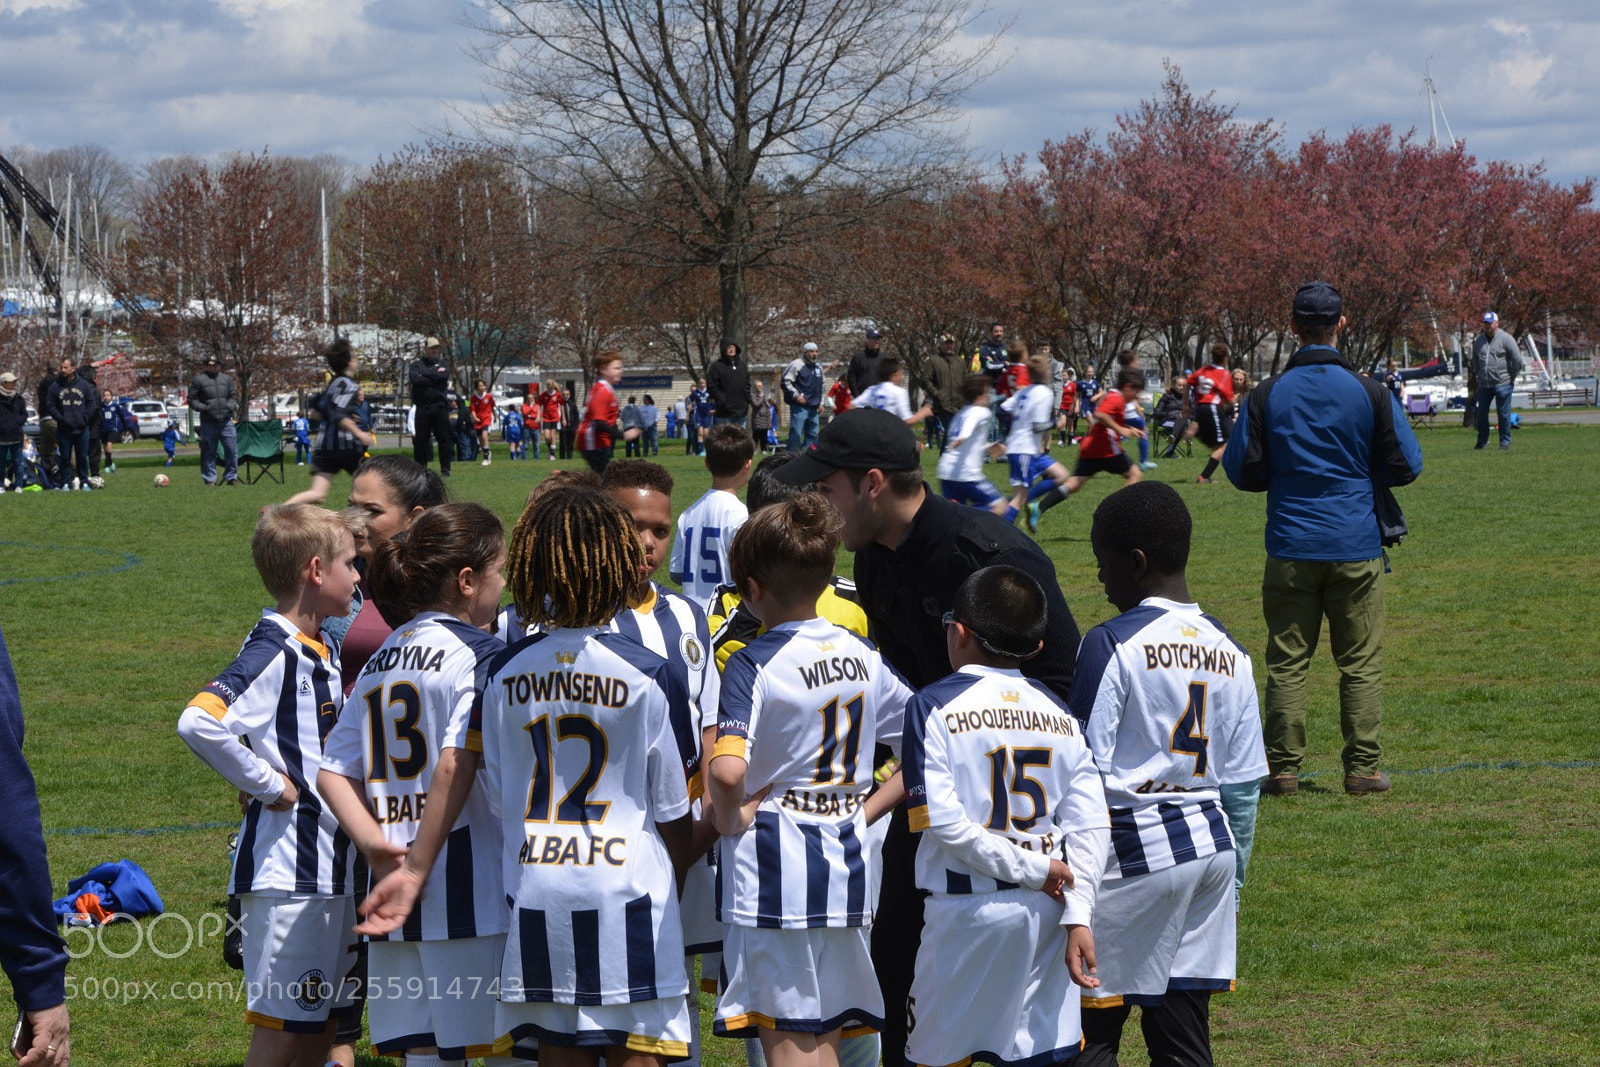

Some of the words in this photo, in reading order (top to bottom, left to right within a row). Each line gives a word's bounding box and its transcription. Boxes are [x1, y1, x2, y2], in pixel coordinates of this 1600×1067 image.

[682, 527, 722, 583] 15
[798, 656, 870, 690] WILSON
[1143, 643, 1235, 678] BOTCHWAY
[502, 671, 629, 708] TOWNSEND
[363, 680, 427, 783] 13
[810, 691, 865, 786] 11
[1169, 680, 1209, 777] 4
[523, 713, 612, 825] 12
[984, 744, 1052, 833] 15
[781, 789, 841, 816] ALBA
[518, 834, 582, 866] ALBA
[586, 834, 626, 866] FC
